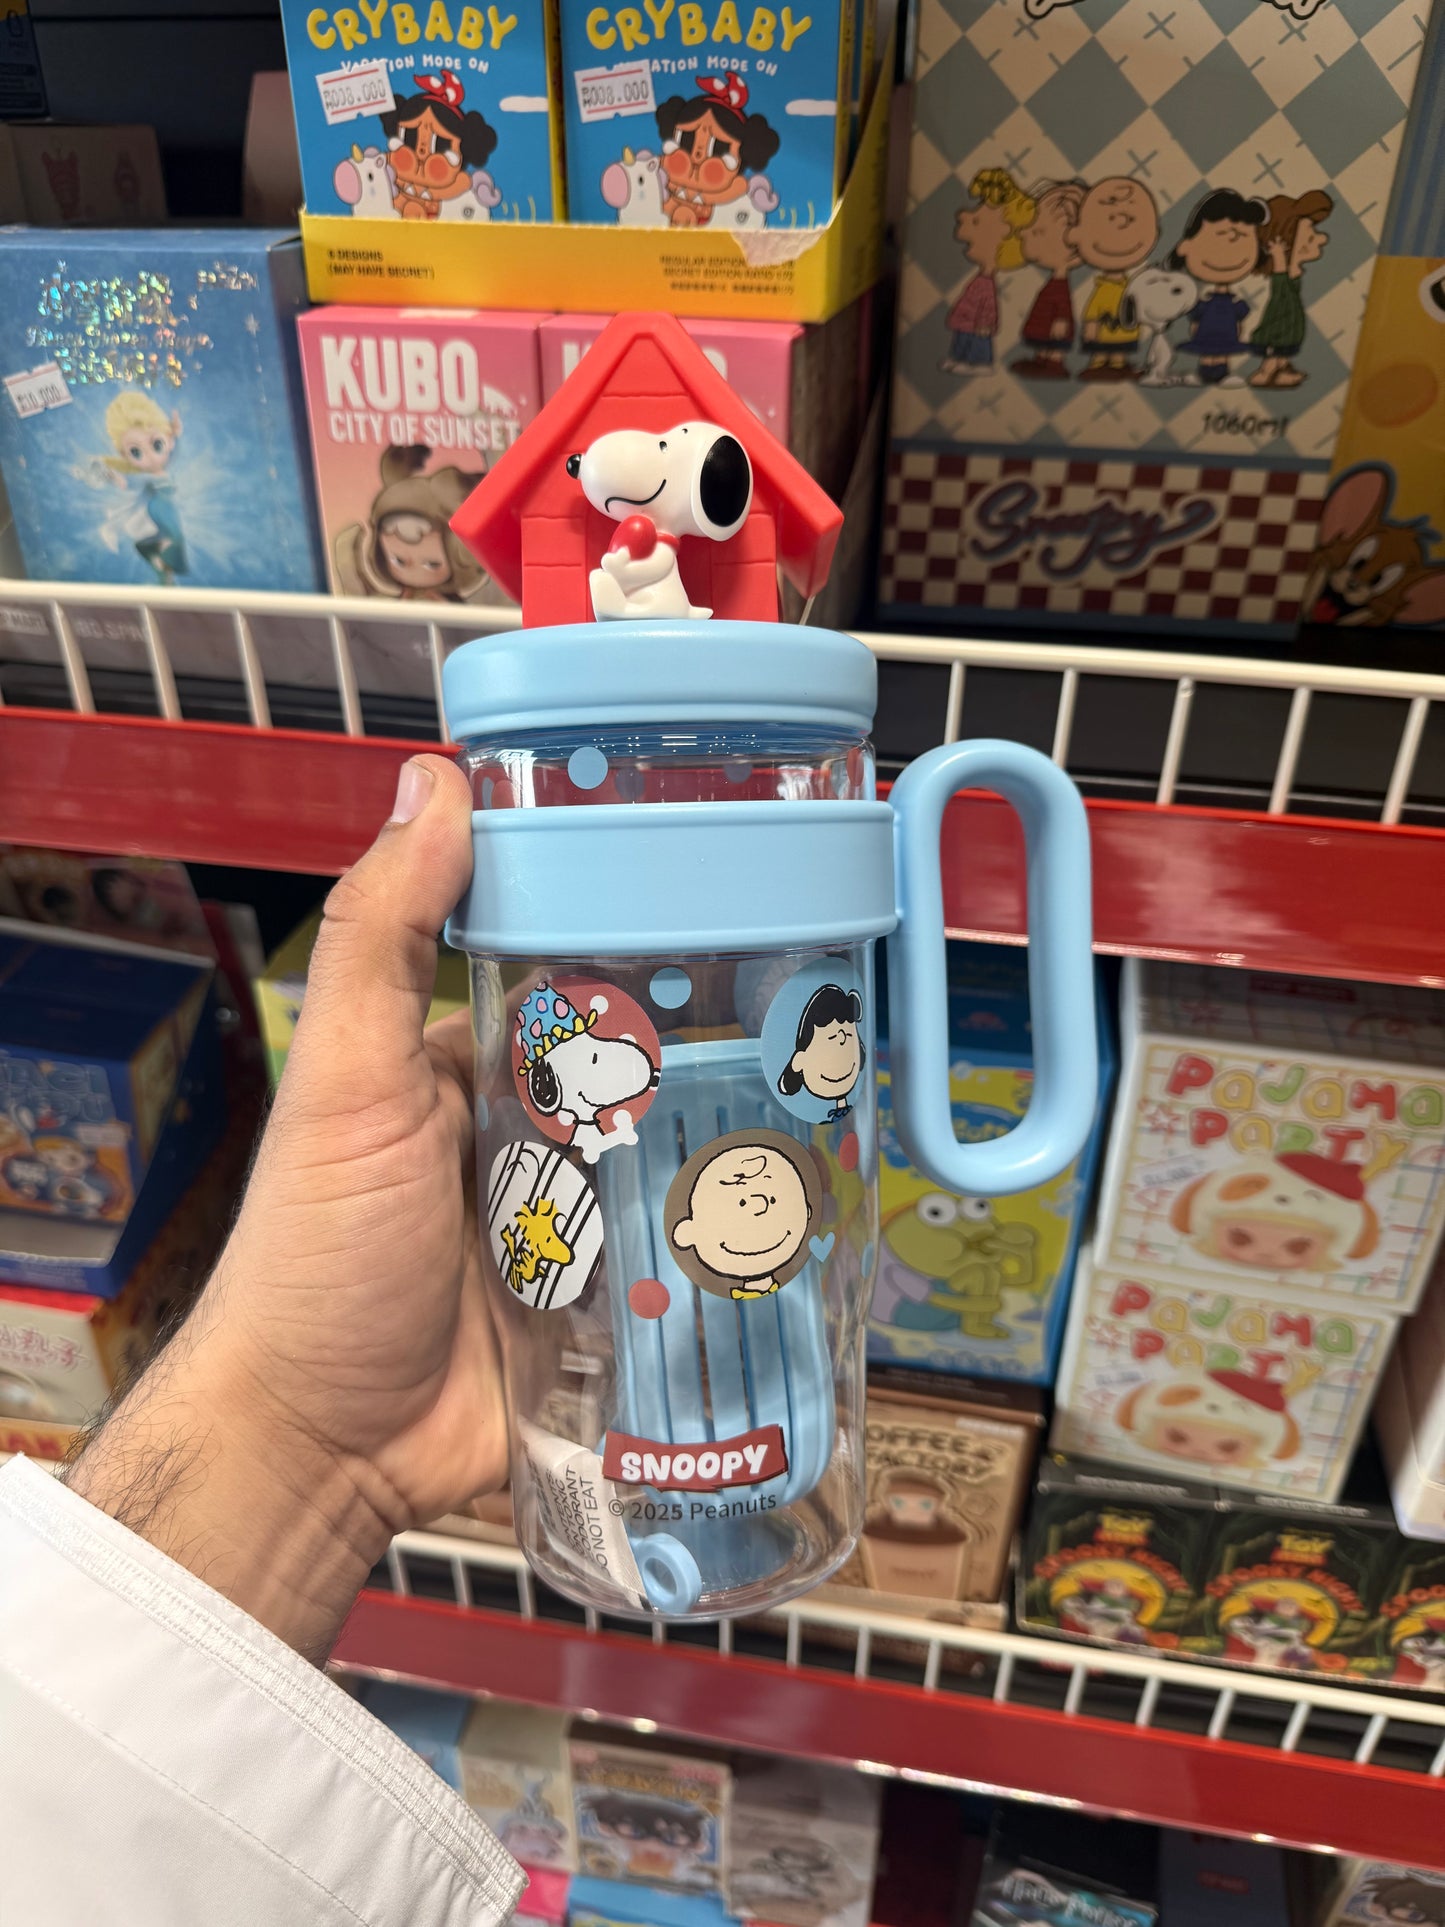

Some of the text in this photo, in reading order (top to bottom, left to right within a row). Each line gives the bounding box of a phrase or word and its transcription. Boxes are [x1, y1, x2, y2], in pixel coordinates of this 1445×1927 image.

[307, 0, 518, 50] CRYBABY
[586, 0, 812, 52] CRYBABY
[422, 54, 462, 70] MODE
[468, 59, 489, 74] ON
[707, 56, 748, 72] MODE
[756, 60, 778, 76] ON
[321, 335, 479, 415] KUBO
[330, 411, 520, 450] CITY OF SUNSET
[866, 1424, 972, 1450] OFFEE
[620, 1444, 769, 1481] SNOOPY
[579, 1475, 599, 1511] EAT
[631, 1501, 683, 1521] 2025
[690, 1493, 777, 1521] Peanuts
[587, 1513, 605, 1550] NOT
